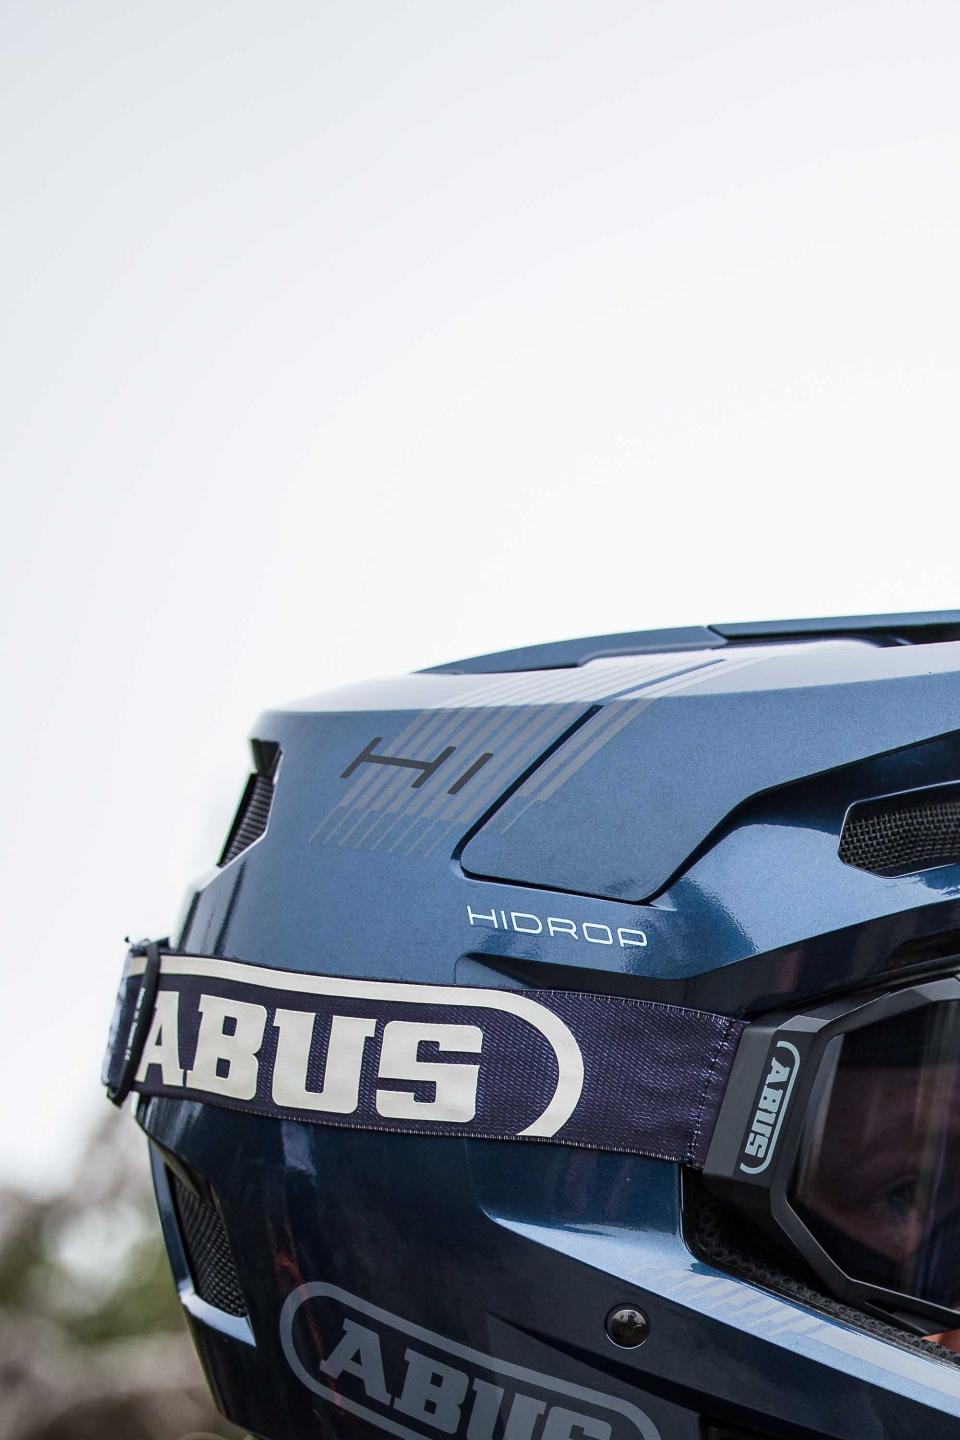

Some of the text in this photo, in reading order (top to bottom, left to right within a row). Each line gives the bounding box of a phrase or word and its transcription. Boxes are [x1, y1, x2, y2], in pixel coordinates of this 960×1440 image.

[340, 737, 493, 794] HI
[467, 905, 648, 947] HIDROP
[134, 990, 484, 1123] ABUS
[744, 1057, 791, 1158] ABUS
